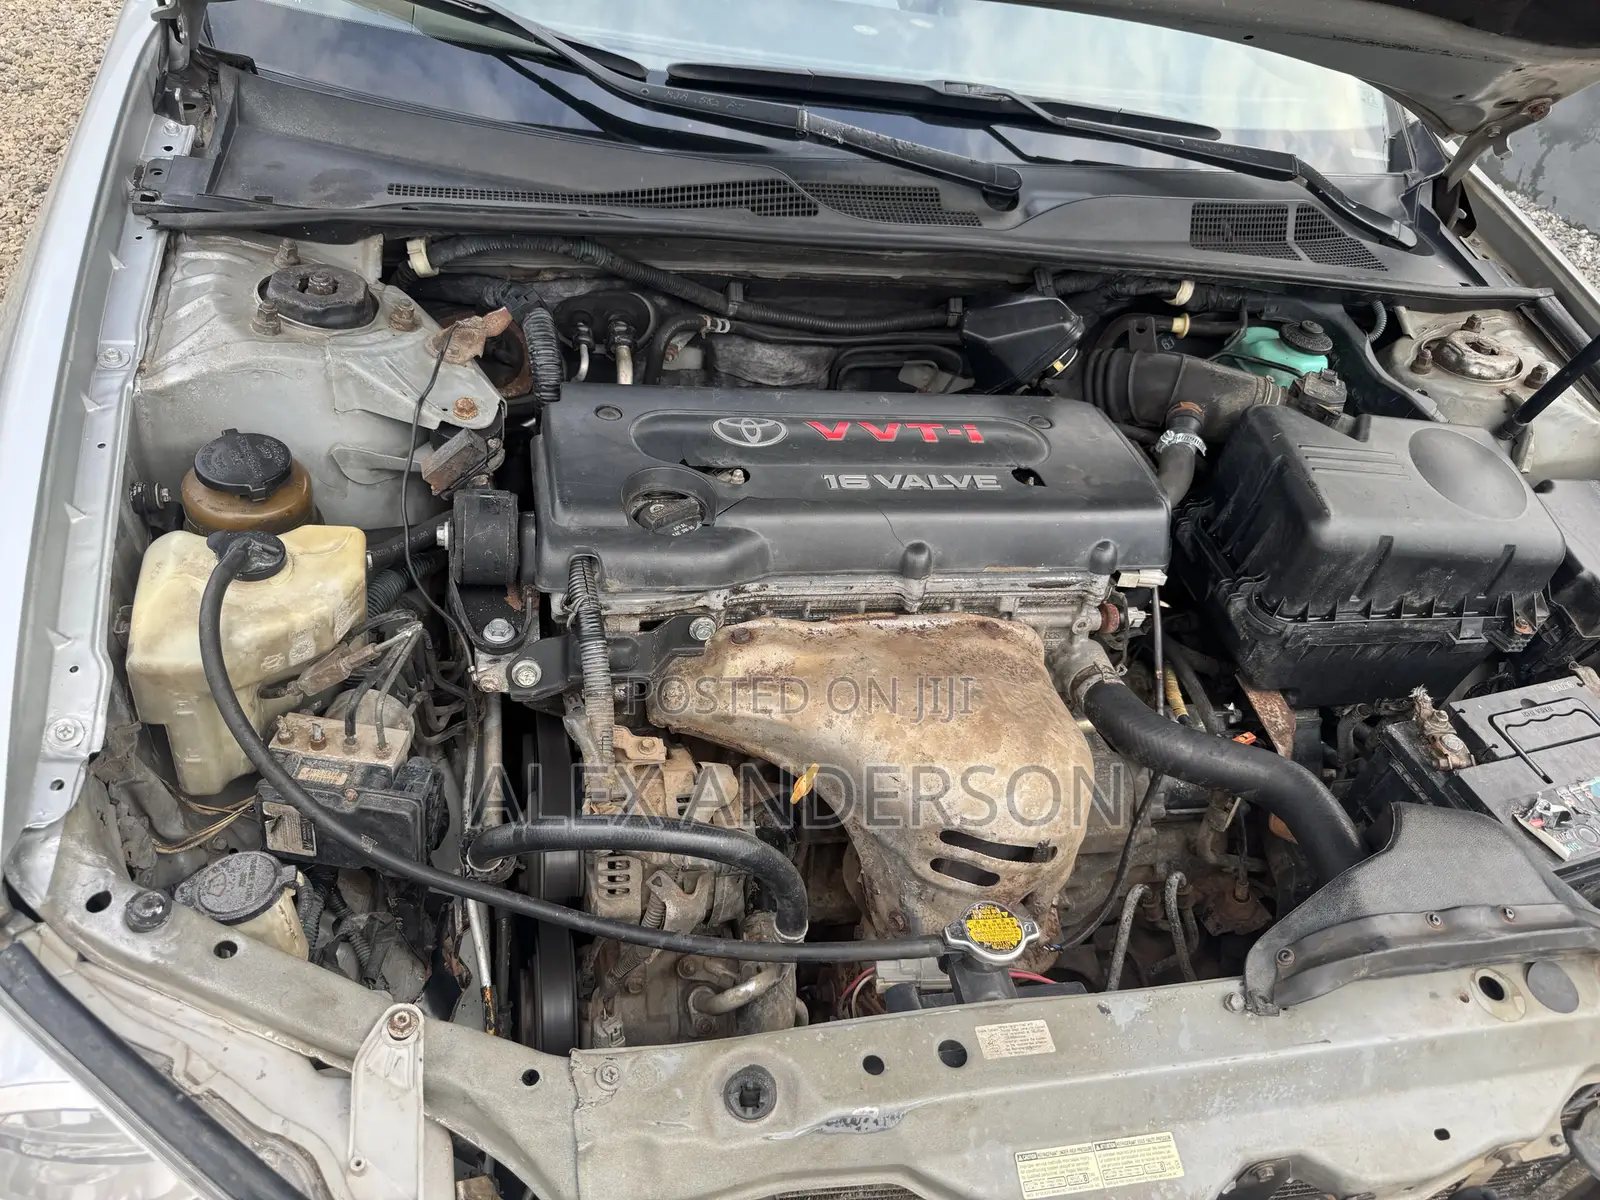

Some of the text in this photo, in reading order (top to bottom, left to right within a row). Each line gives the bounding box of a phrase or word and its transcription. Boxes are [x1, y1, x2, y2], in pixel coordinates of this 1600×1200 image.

[805, 421, 984, 443] VVT-i
[822, 473, 1002, 490] 16 VALVE
